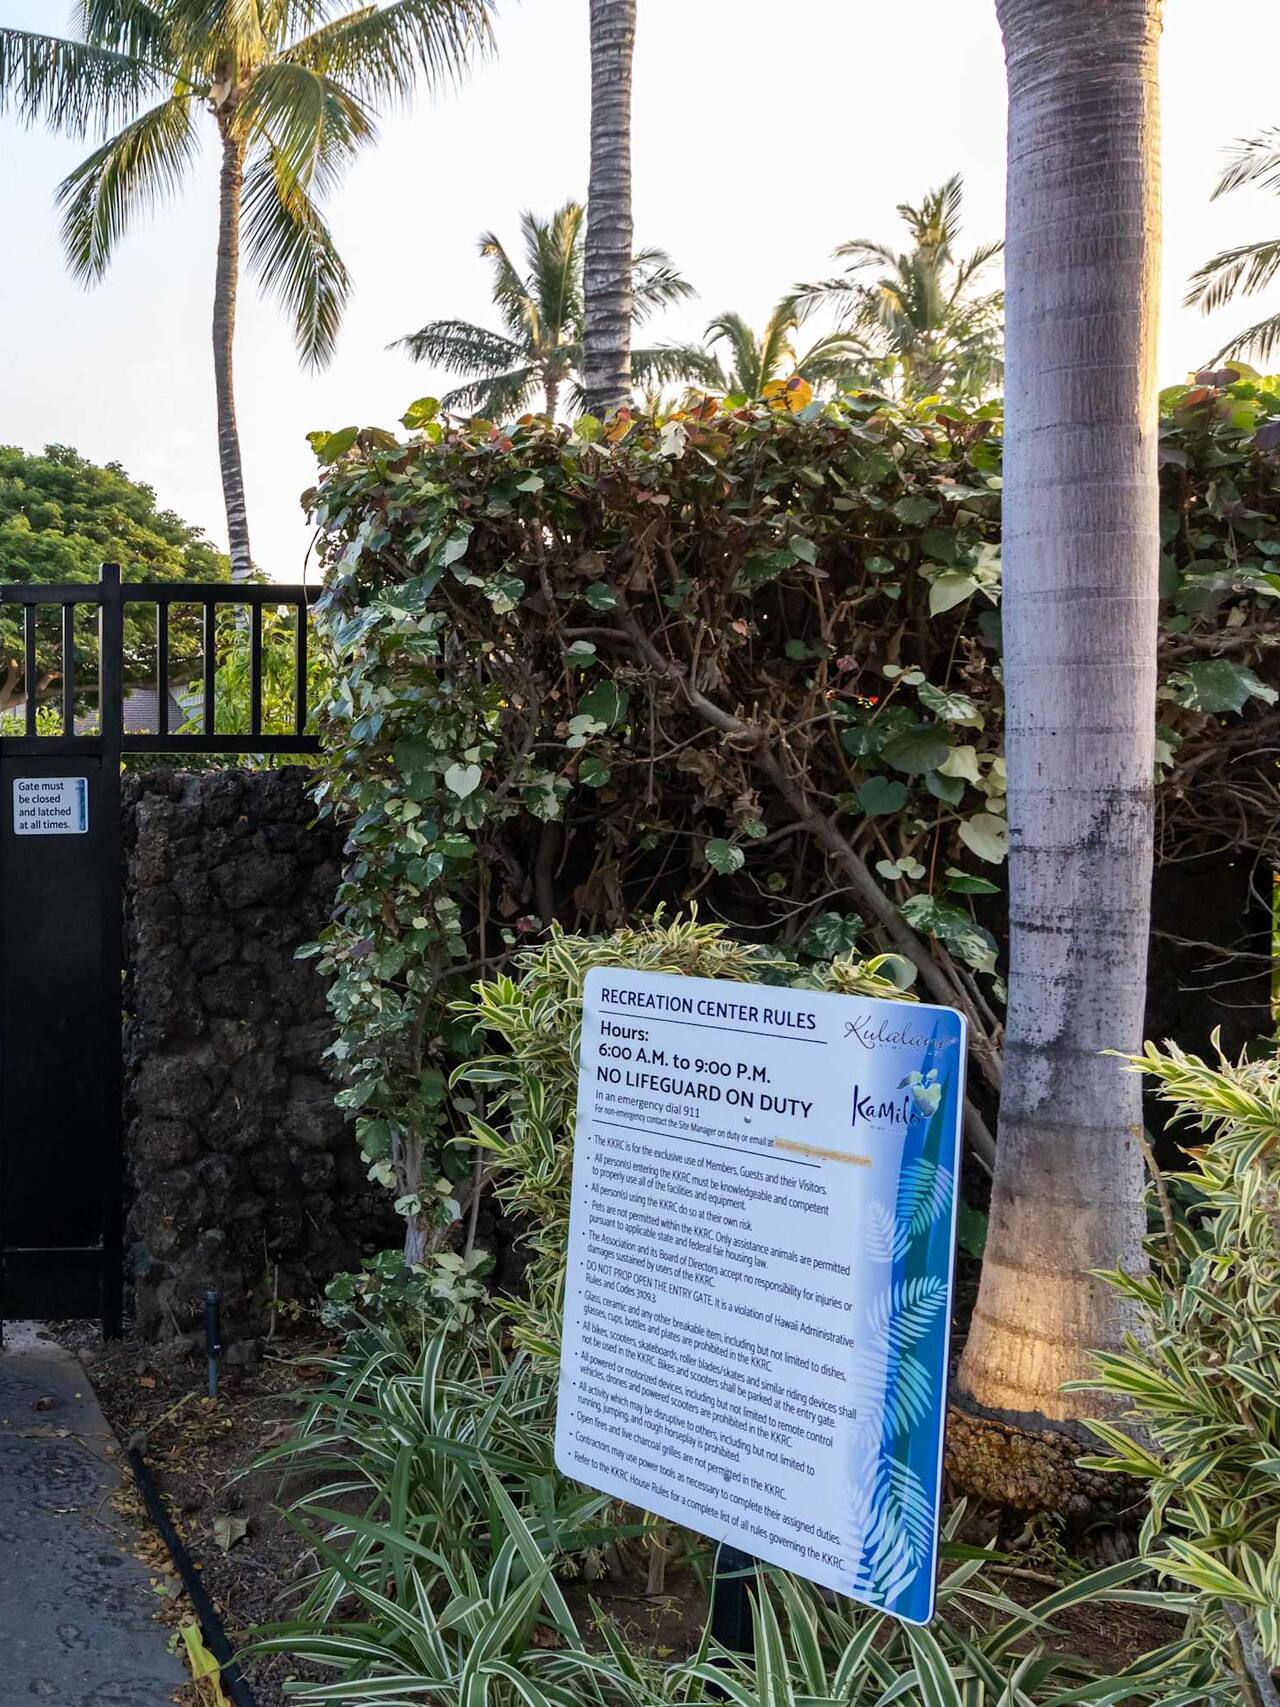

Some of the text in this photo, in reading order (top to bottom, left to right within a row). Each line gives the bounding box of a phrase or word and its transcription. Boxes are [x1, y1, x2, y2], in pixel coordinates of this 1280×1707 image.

[19, 782, 64, 791] Gate must
[19, 794, 60, 803] be closed
[19, 807, 71, 816] and latched
[31, 820, 41, 829] all
[43, 820, 70, 829] times.
[601, 988, 816, 1030] RECREATION CENTER RULES
[601, 1020, 649, 1042] Hours:
[599, 1043, 771, 1084] 6:00 A.M. to 9:00 P.M.
[595, 1089, 700, 1118] In an emergency dial 911
[597, 1066, 813, 1118] NO LIFEGUARD ON DUTY
[594, 1103, 774, 1148] For non-emergency contact the Site Manager on duty or email at
[592, 1165, 599, 1176] to
[599, 1169, 626, 1184] properly
[625, 1175, 638, 1185] use
[638, 1176, 646, 1186] all
[647, 1178, 655, 1189] of
[655, 1179, 666, 1192] the
[667, 1182, 693, 1198] facilities
[694, 1190, 708, 1201] and
[594, 1134, 606, 1147] The
[606, 1137, 625, 1151] KKRC
[625, 1141, 631, 1152] is
[632, 1142, 641, 1153] for
[642, 1145, 653, 1157] the
[653, 1149, 683, 1164] exclusive
[684, 1156, 696, 1167] use
[697, 1157, 705, 1168] of
[739, 1165, 764, 1181] Guests
[765, 1173, 779, 1185] and
[780, 1174, 798, 1188] their
[594, 1153, 603, 1164] All
[632, 1163, 659, 1179] entering
[660, 1167, 671, 1179] the
[672, 1169, 691, 1184] KKRC
[691, 1176, 709, 1188] must
[710, 1178, 719, 1190] be
[720, 1180, 772, 1203] knowledgeable
[773, 1195, 788, 1206] and
[788, 1198, 829, 1216] competent
[589, 1214, 616, 1229] pursuant
[617, 1220, 624, 1231] to
[624, 1223, 657, 1239] applicable
[657, 1232, 674, 1244] state
[674, 1237, 688, 1248] and
[688, 1237, 712, 1254] federal
[713, 1244, 724, 1257] fair
[725, 1247, 753, 1268] housing
[592, 1199, 605, 1213] Pets
[606, 1205, 616, 1215] are
[616, 1208, 628, 1219] not
[628, 1211, 660, 1227] permitted
[660, 1218, 680, 1232] within
[681, 1223, 693, 1235] the
[715, 1231, 732, 1248] Only
[733, 1238, 769, 1255] assistance
[770, 1247, 798, 1263] animals
[799, 1255, 812, 1266] are
[813, 1259, 851, 1276] permitted
[588, 1229, 853, 1311] The Association and its Board of Directors accept no responsibility for injuries or
[586, 1259, 597, 1272] DO
[598, 1263, 613, 1276] NOT
[613, 1267, 632, 1282] PROP
[633, 1273, 653, 1288] OPEN
[654, 1279, 668, 1293] THE
[668, 1283, 693, 1299] ENTRY
[714, 1297, 720, 1308] It
[721, 1299, 727, 1310] is
[728, 1303, 733, 1312] a
[734, 1304, 764, 1321] violation
[765, 1313, 774, 1324] of
[799, 1322, 854, 1348] Administrative
[575, 1430, 610, 1453] Contractors
[611, 1447, 625, 1461] may
[625, 1453, 638, 1464] use
[638, 1457, 659, 1472] power
[659, 1464, 676, 1479] tools
[677, 1472, 685, 1483] as
[686, 1476, 720, 1499] necessary
[721, 1488, 729, 1500] to
[729, 1494, 763, 1514] complete
[764, 1505, 781, 1521] their
[782, 1514, 815, 1535] assigned
[574, 1450, 591, 1466] Refer
[591, 1458, 598, 1469] to
[599, 1461, 610, 1474] the
[610, 1465, 629, 1482] KKRC
[629, 1474, 651, 1490] House
[651, 1481, 669, 1499] Rules
[670, 1489, 680, 1502] for
[680, 1496, 686, 1505] a
[687, 1499, 719, 1519] complete
[720, 1509, 730, 1524] list
[731, 1516, 740, 1527] of
[740, 1520, 749, 1531] all
[750, 1524, 768, 1539] rules
[769, 1532, 806, 1557] governing
[807, 1546, 820, 1561] the
